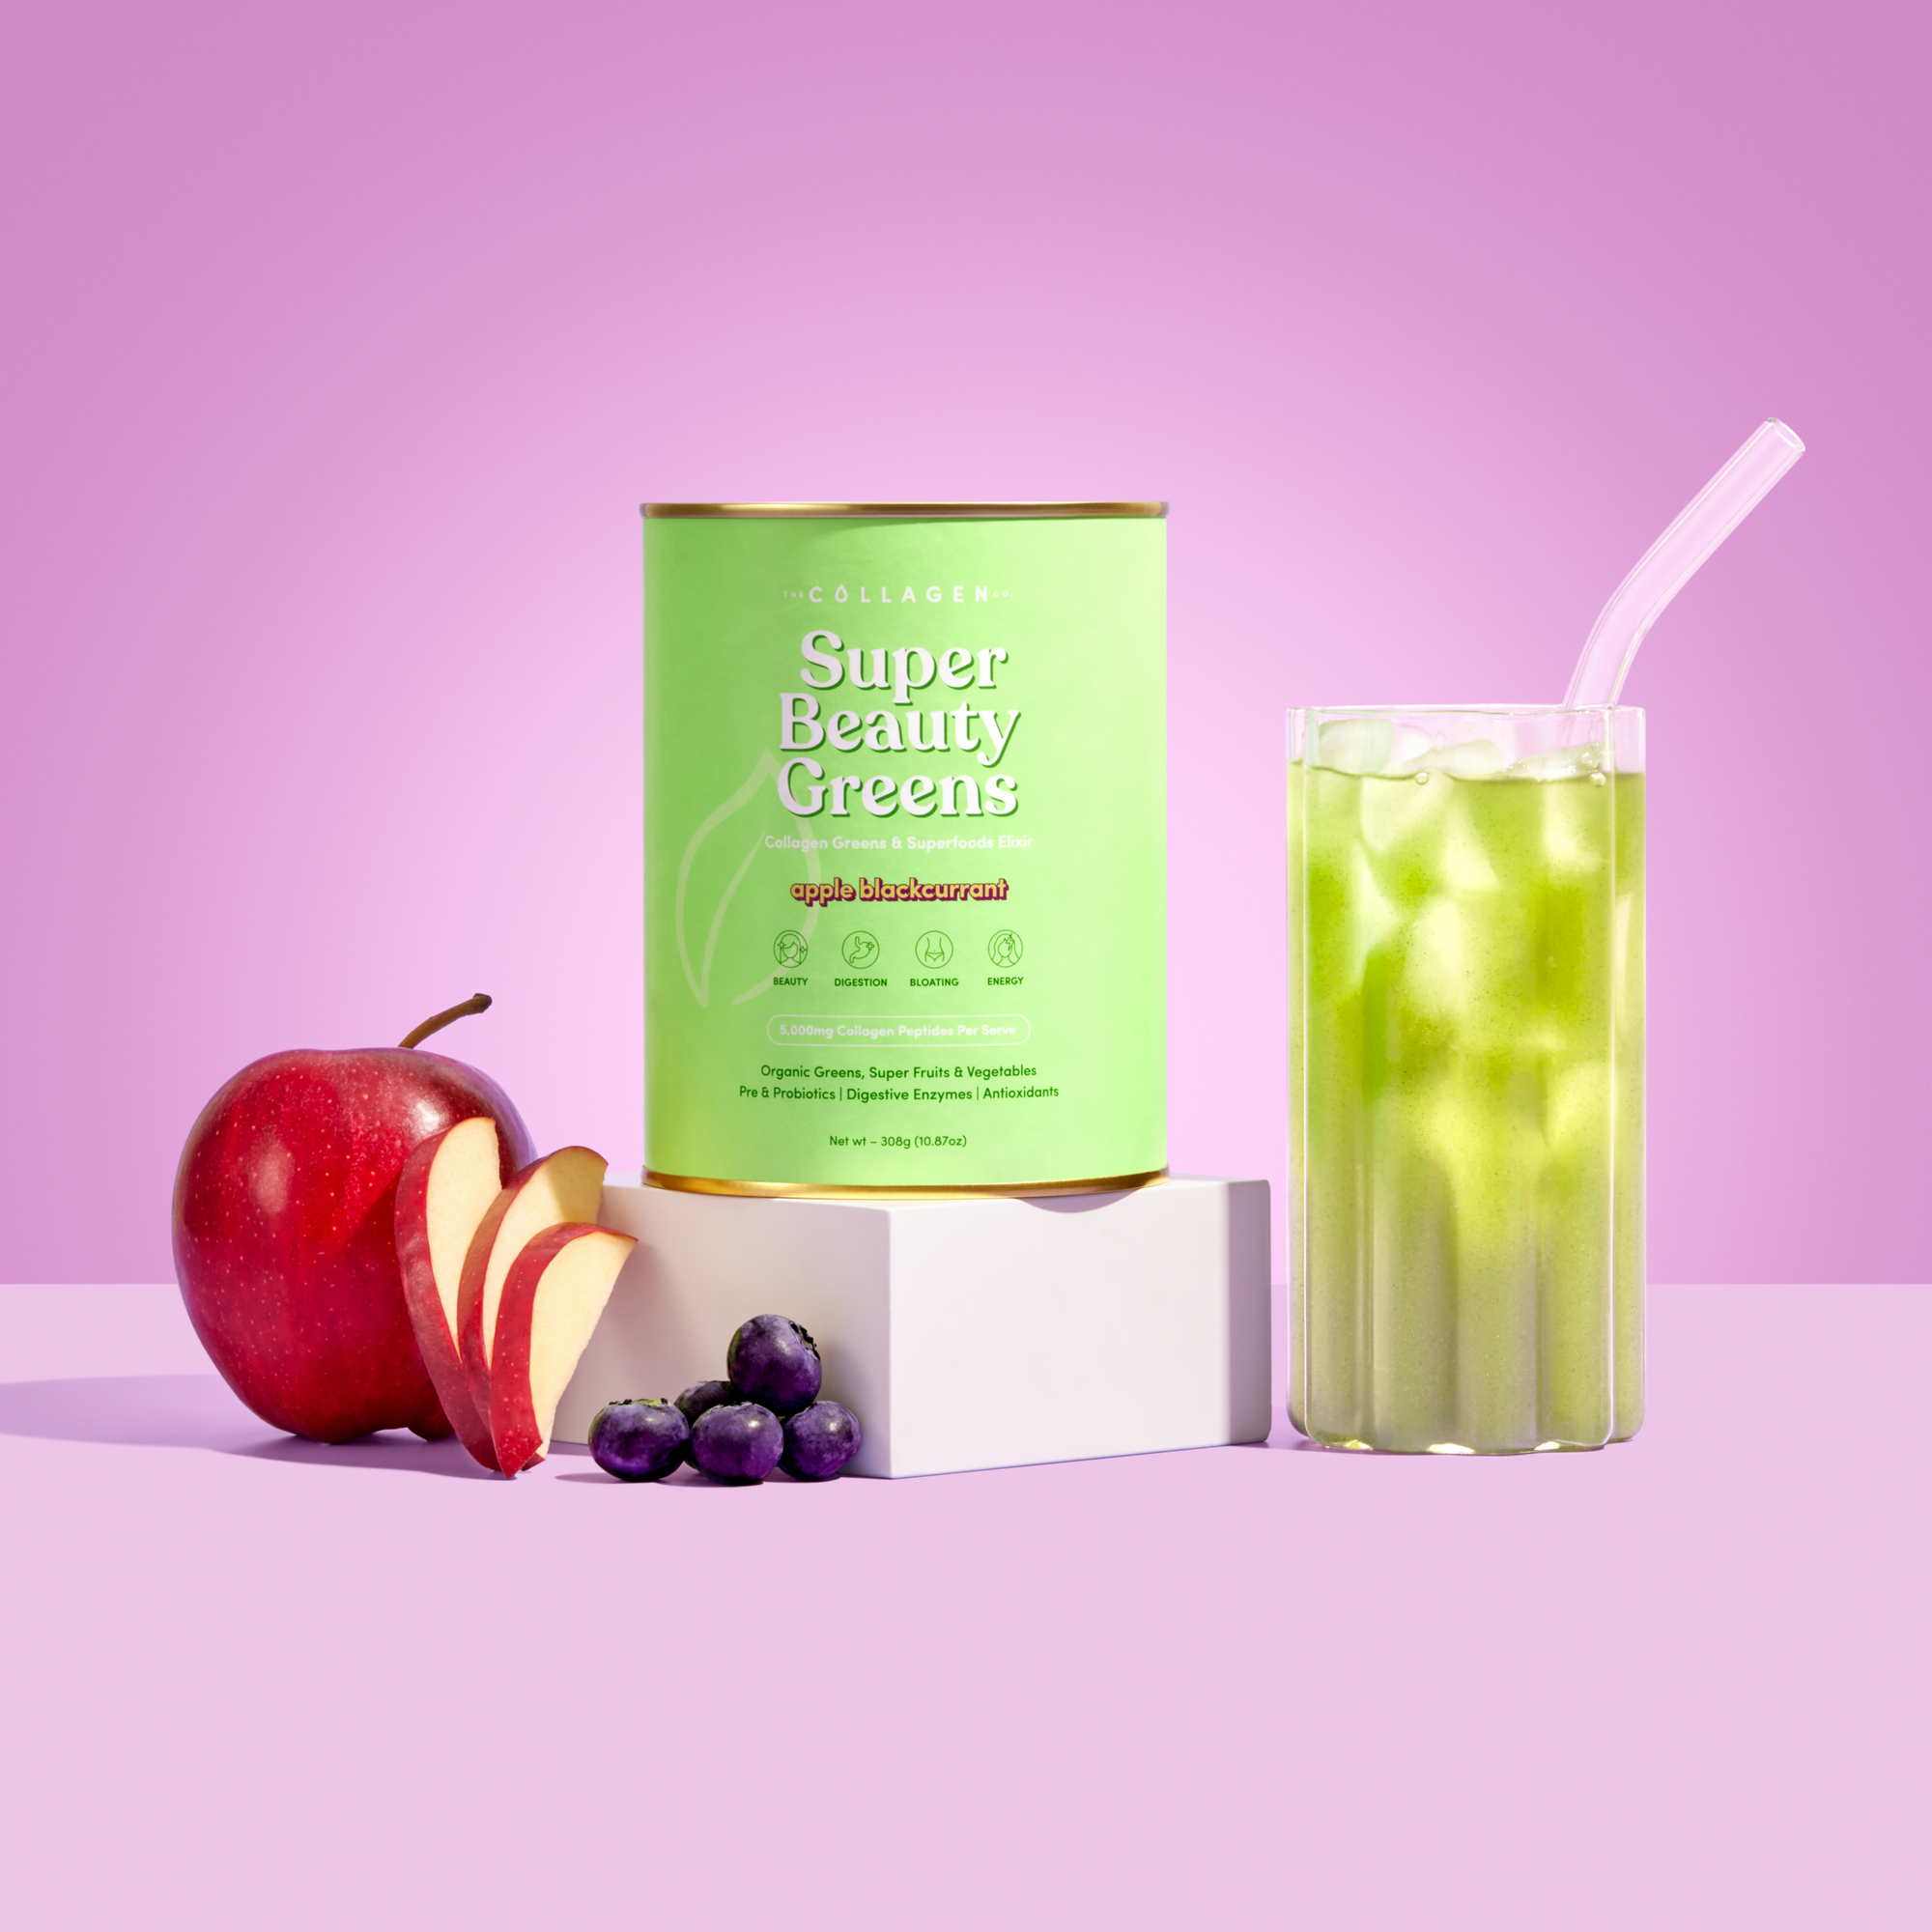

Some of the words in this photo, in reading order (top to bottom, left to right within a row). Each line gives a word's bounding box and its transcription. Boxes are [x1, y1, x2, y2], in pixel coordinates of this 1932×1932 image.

[809, 583, 988, 604] COLLAGEN
[800, 630, 1009, 706] Super
[780, 693, 1021, 768] Beauty
[777, 756, 1018, 818] Greens
[764, 835, 828, 852] Collagen
[832, 836, 887, 850] Greens
[892, 836, 902, 849] &
[907, 835, 994, 853] Superfoods
[999, 835, 1034, 848] Elixir
[790, 877, 856, 907] apple
[859, 877, 1009, 901] blackcurrant
[773, 977, 809, 986] BEAUTY
[834, 978, 888, 987] DIGESTION
[909, 978, 959, 987] BLOATING
[987, 977, 1024, 986] ENERGY
[780, 1024, 834, 1038] 5,000mg
[837, 1024, 895, 1039] Collagen
[898, 1024, 953, 1039] Peptides
[957, 1024, 979, 1037] Per
[981, 1024, 1016, 1036] Serve
[760, 1065, 810, 1080] Organic
[813, 1065, 866, 1081] Greens,
[868, 1066, 910, 1081] Super
[913, 1066, 951, 1079] Fruits
[953, 1066, 963, 1078] &
[967, 1065, 1037, 1080] Vegetables
[739, 1086, 758, 1098] Pre
[761, 1087, 770, 1098] &
[773, 1087, 836, 1100] Probiotics
[846, 1088, 910, 1103] Digestive
[913, 1088, 973, 1103] Enzymes
[983, 1086, 1060, 1099] Antioxidants
[829, 1136, 849, 1147] Net
[852, 1137, 867, 1147] wt
[881, 1136, 911, 1150] 308g
[914, 1135, 967, 1149] (10.87oz)
